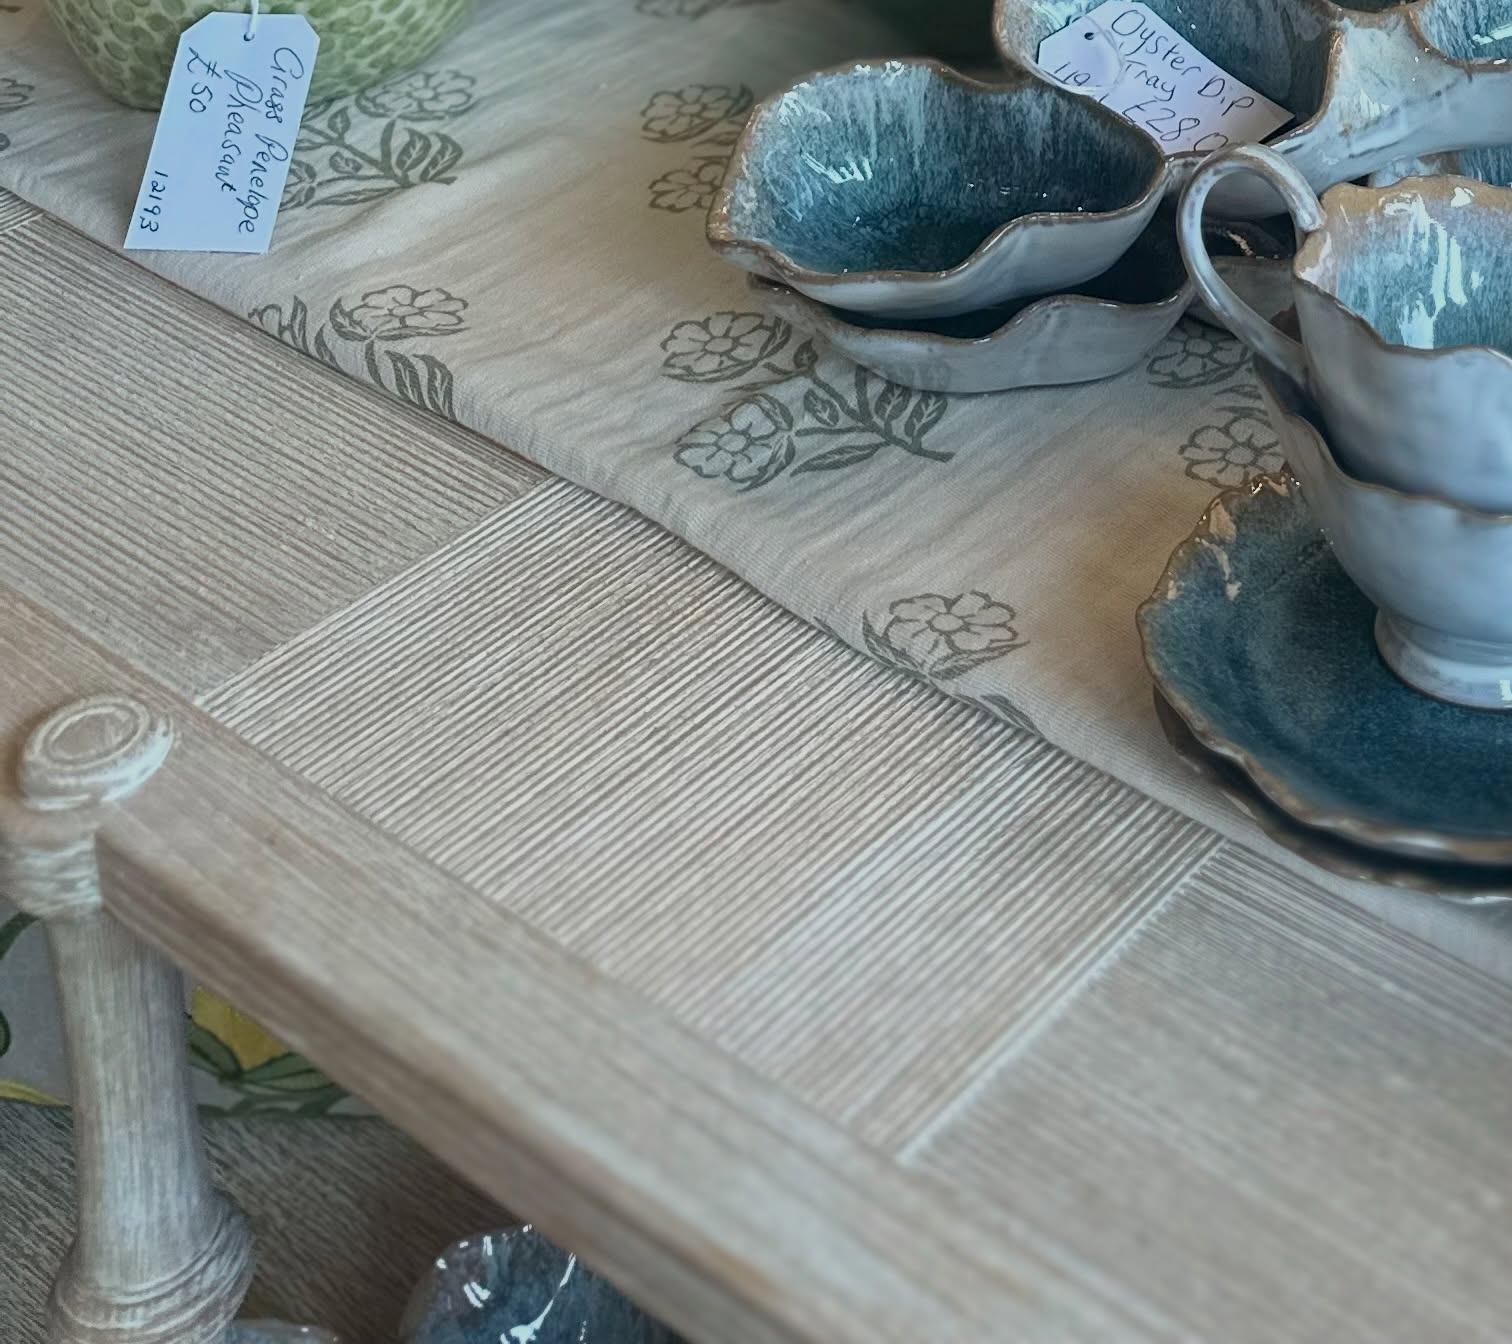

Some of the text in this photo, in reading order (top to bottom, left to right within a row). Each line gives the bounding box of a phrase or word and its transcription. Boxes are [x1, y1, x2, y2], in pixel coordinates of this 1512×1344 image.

[187, 46, 223, 113] £50
[1111, 9, 1255, 118] Oyster Dip
[1124, 59, 1177, 102] Tray
[213, 68, 264, 193] Pheasant
[236, 46, 305, 234] Grass Penelope
[140, 170, 168, 233] 12193
